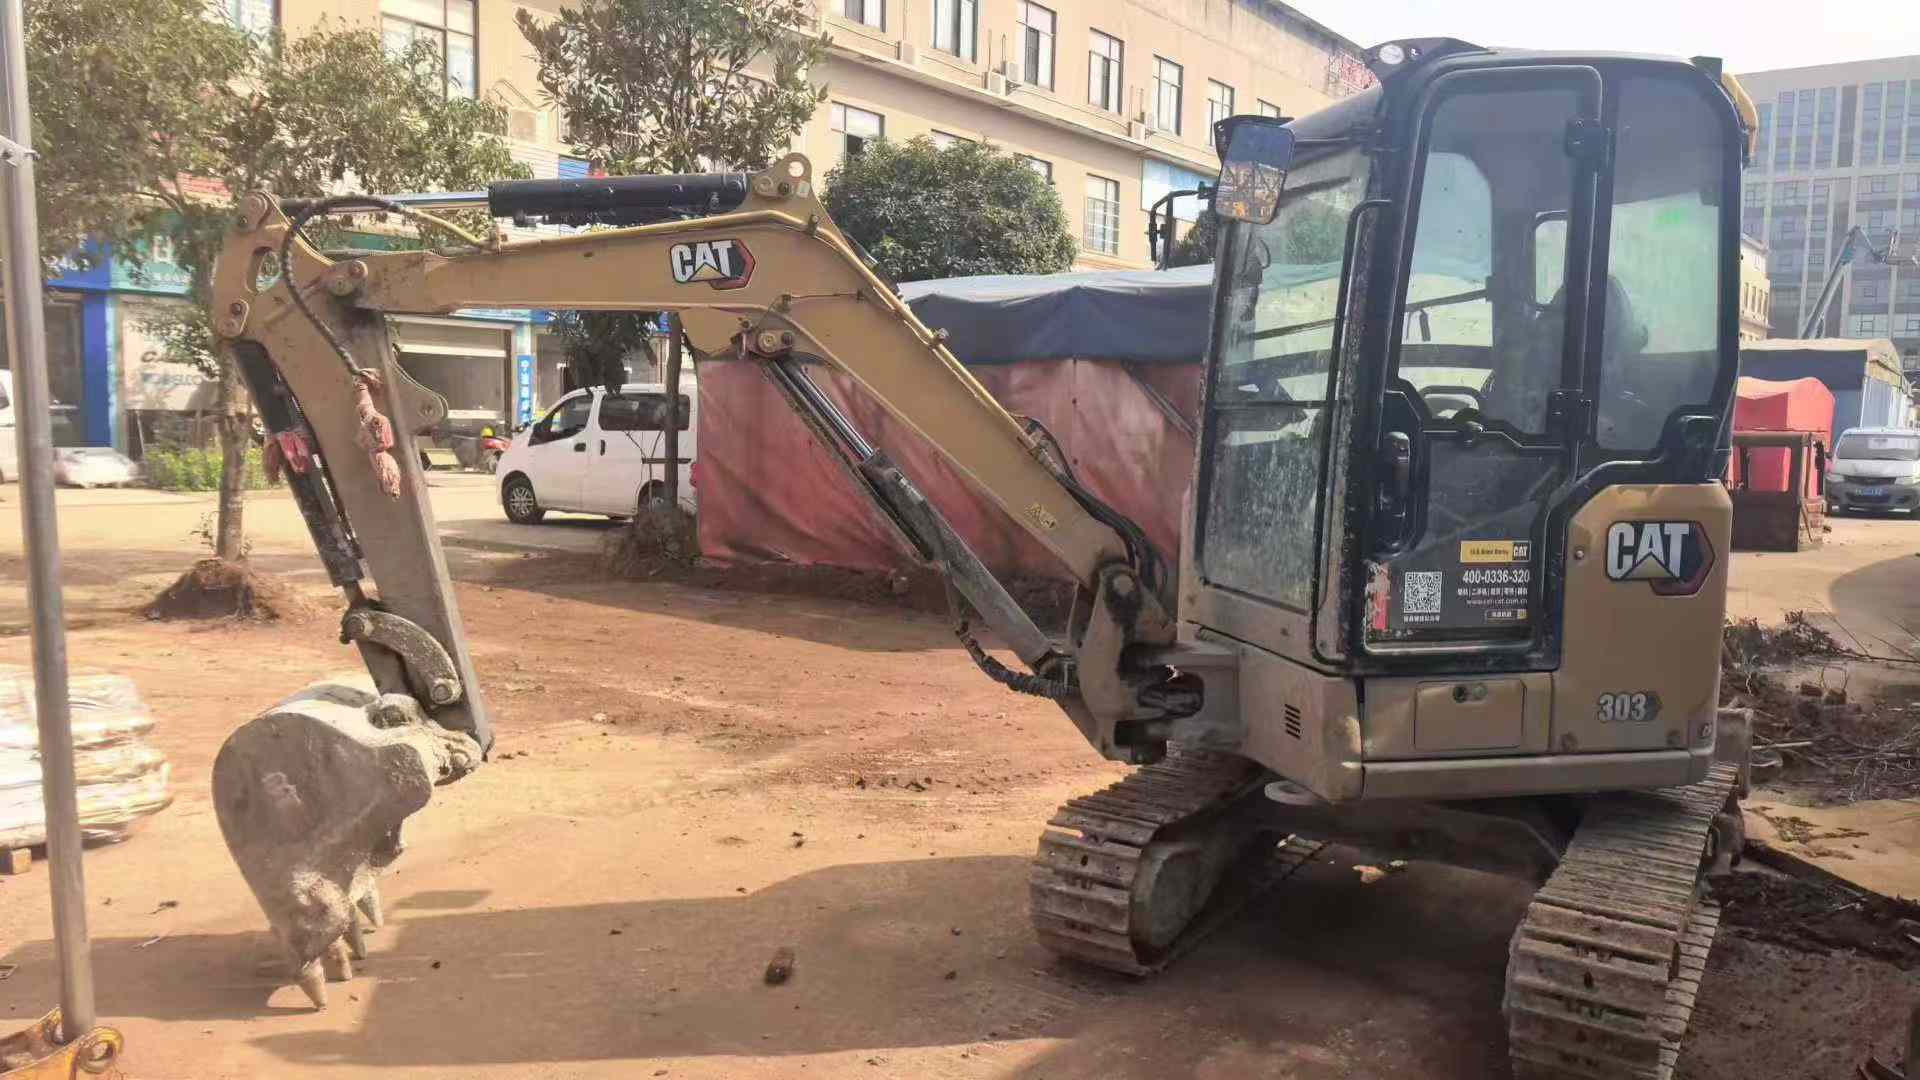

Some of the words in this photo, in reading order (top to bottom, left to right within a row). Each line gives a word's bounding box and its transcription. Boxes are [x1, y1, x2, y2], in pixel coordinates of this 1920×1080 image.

[671, 240, 732, 282] CAT
[1513, 546, 1528, 557] CAT
[1607, 522, 1689, 579] CAT
[1462, 569, 1530, 583] 400-0336-320
[1599, 693, 1647, 721] 303
